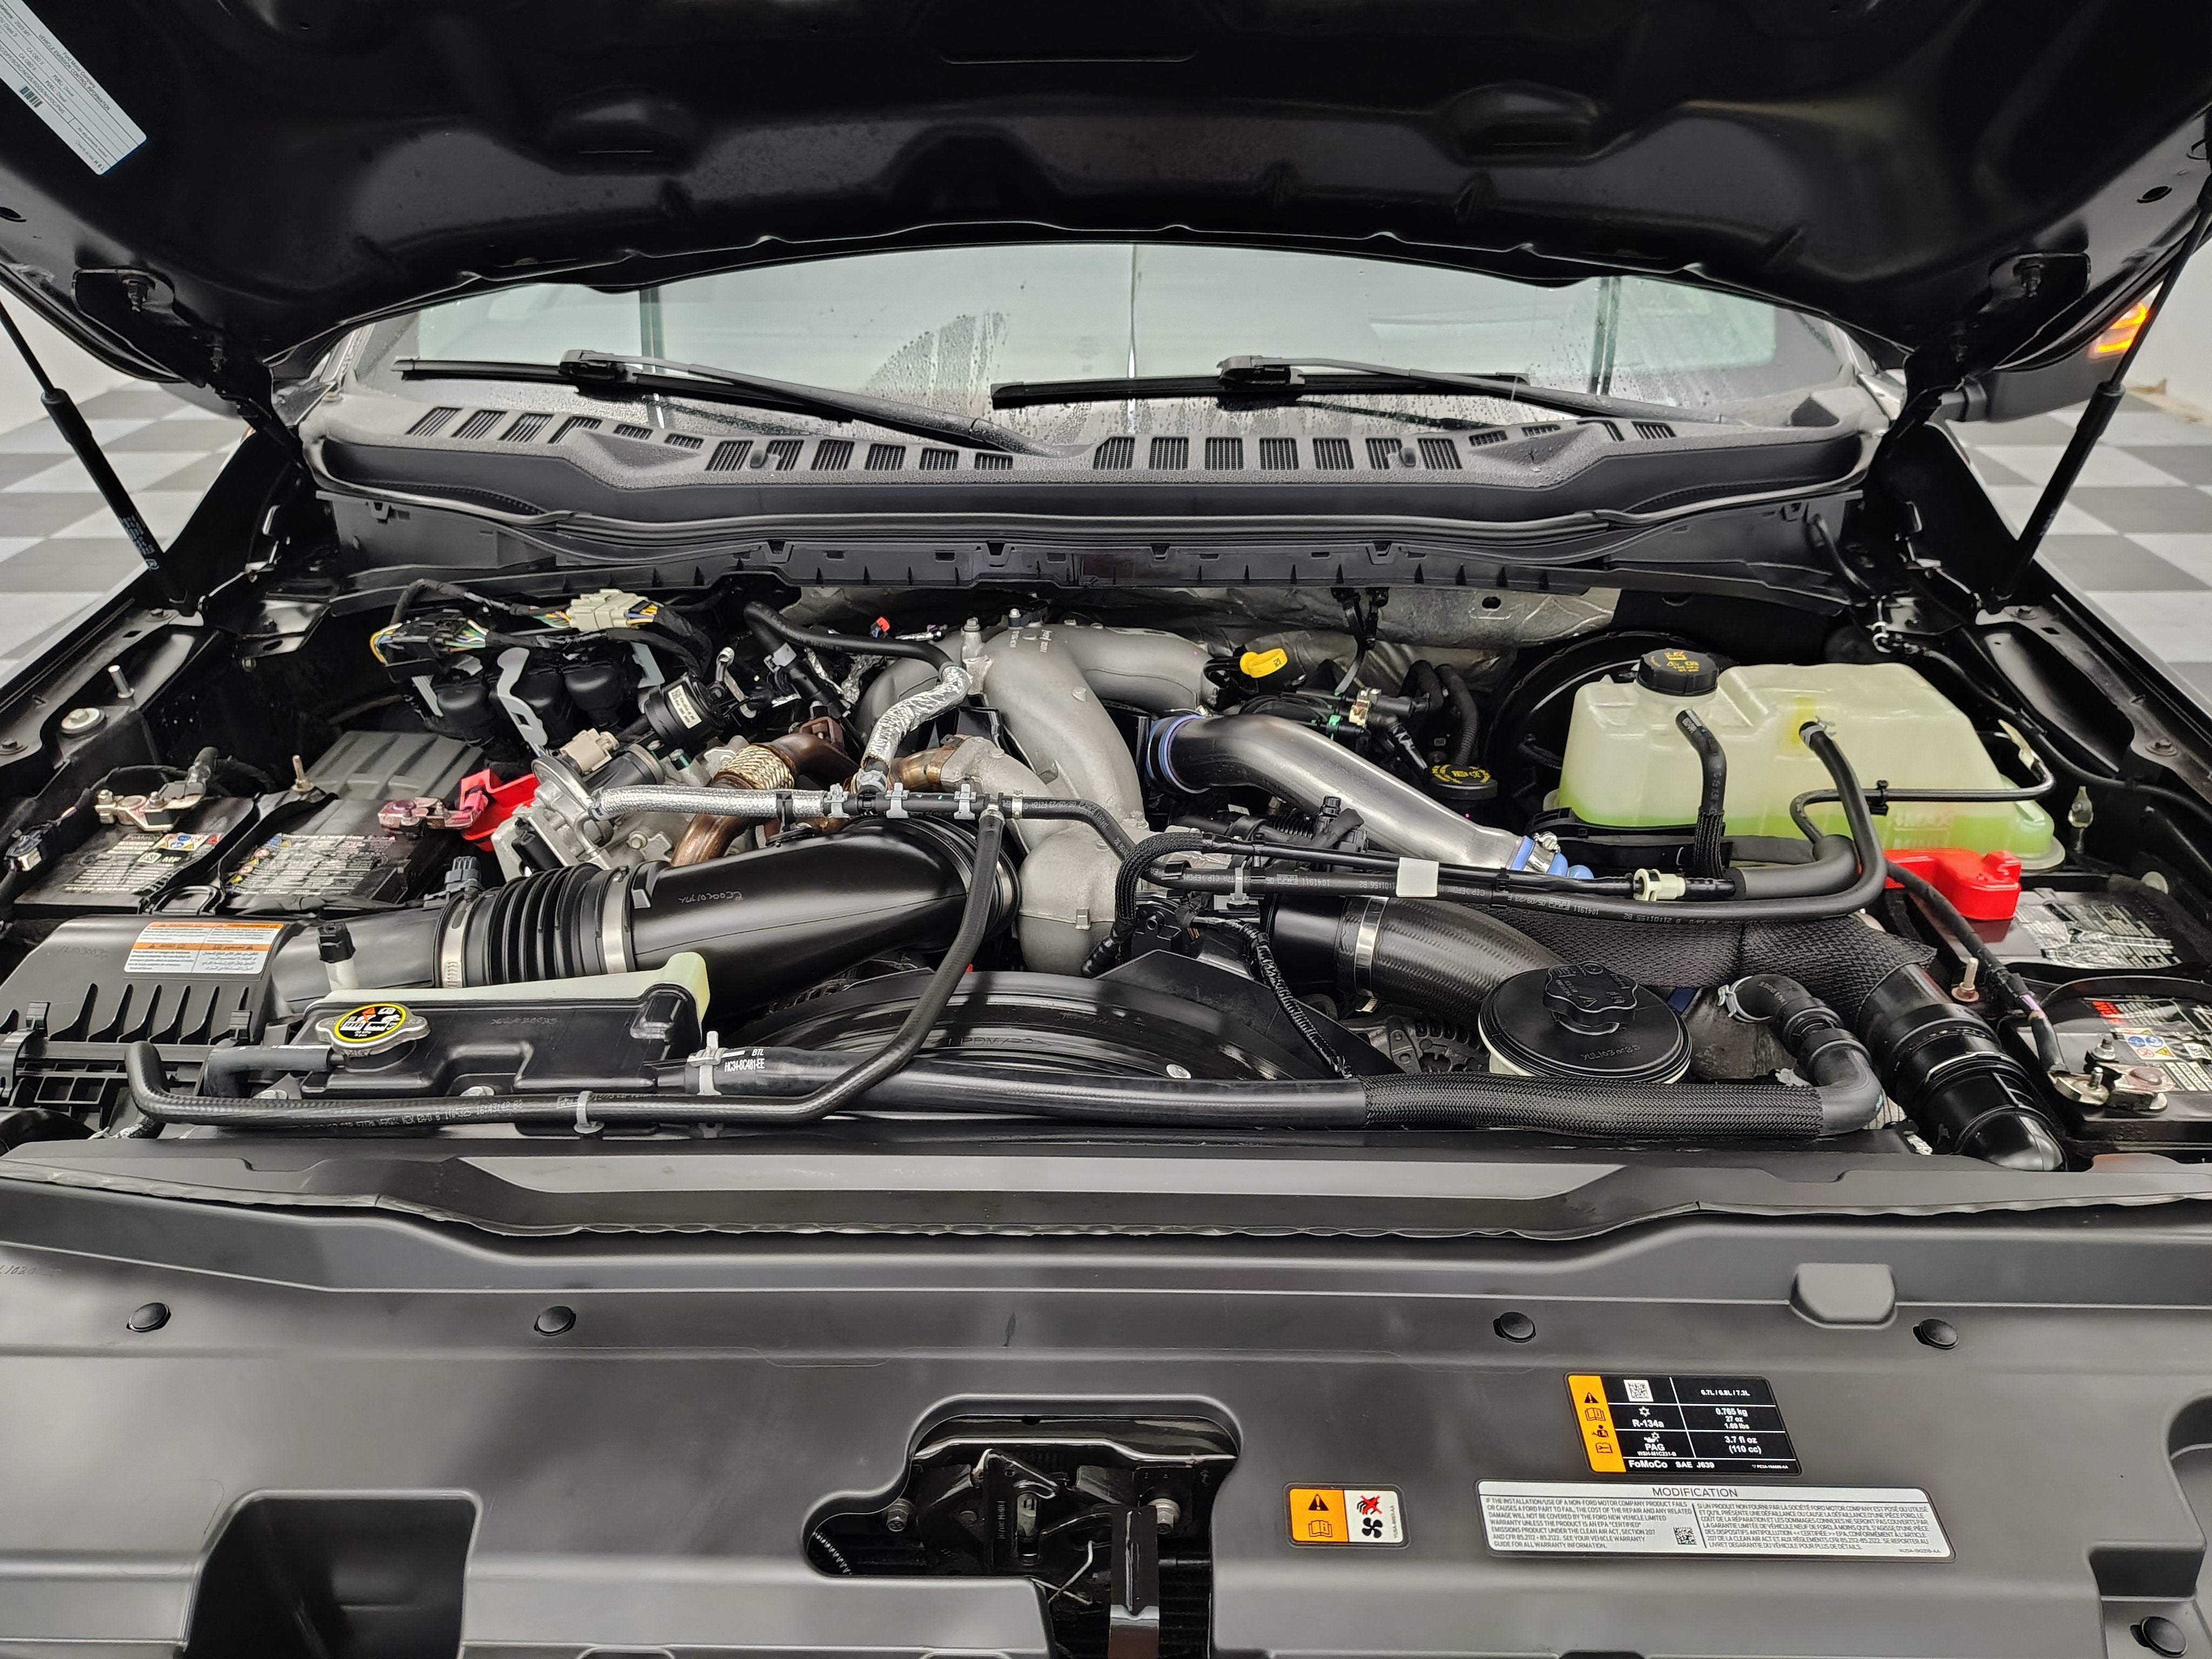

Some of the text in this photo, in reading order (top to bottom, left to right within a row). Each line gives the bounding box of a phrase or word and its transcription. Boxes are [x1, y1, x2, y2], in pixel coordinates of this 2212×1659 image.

[38, 33, 55, 51] VEHICLE
[70, 66, 87, 87] CONTROL
[86, 85, 111, 111] INFORMATION
[1049, 801, 1077, 809] 05/09/23
[1301, 877, 1331, 887] 1041911
[1358, 880, 1367, 889] B2
[1515, 895, 1546, 907] 05/09/23
[1574, 905, 1599, 916] 1041911
[1636, 914, 1673, 923] 21:01:55
[1736, 1408, 1748, 1417] kg
[1632, 1419, 1664, 1428] R-134a
[1738, 1435, 1745, 1444] fl
[1644, 1443, 1665, 1451] PAG
[1729, 1445, 1762, 1454] (110 cc)
[1628, 1460, 1668, 1468] FoMoCo
[1652, 1487, 1738, 1497] MODIFICATION
